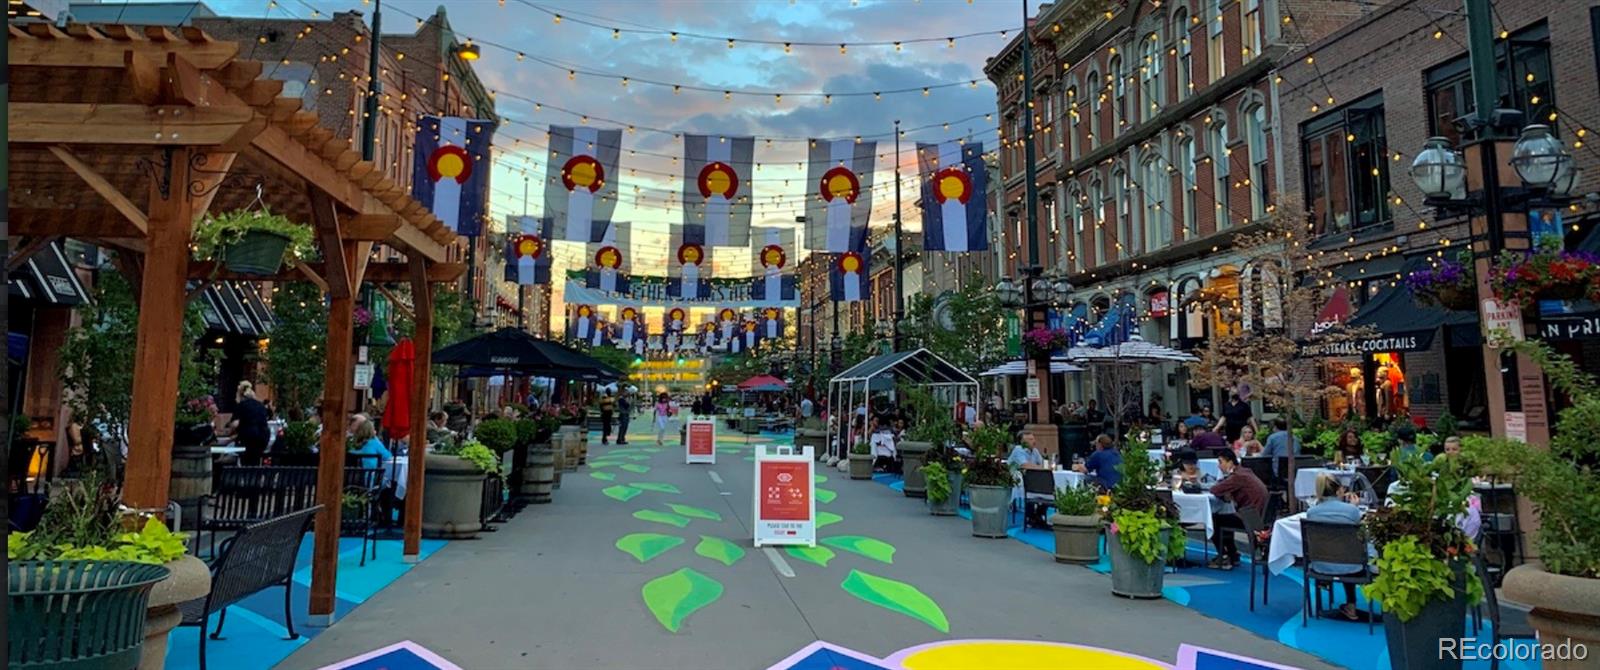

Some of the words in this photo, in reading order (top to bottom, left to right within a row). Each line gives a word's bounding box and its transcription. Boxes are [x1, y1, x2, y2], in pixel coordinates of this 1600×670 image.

[1487, 309, 1519, 321] PARKING
[1325, 340, 1355, 355] STEAKS
[1362, 336, 1416, 352] COCKTAILS
